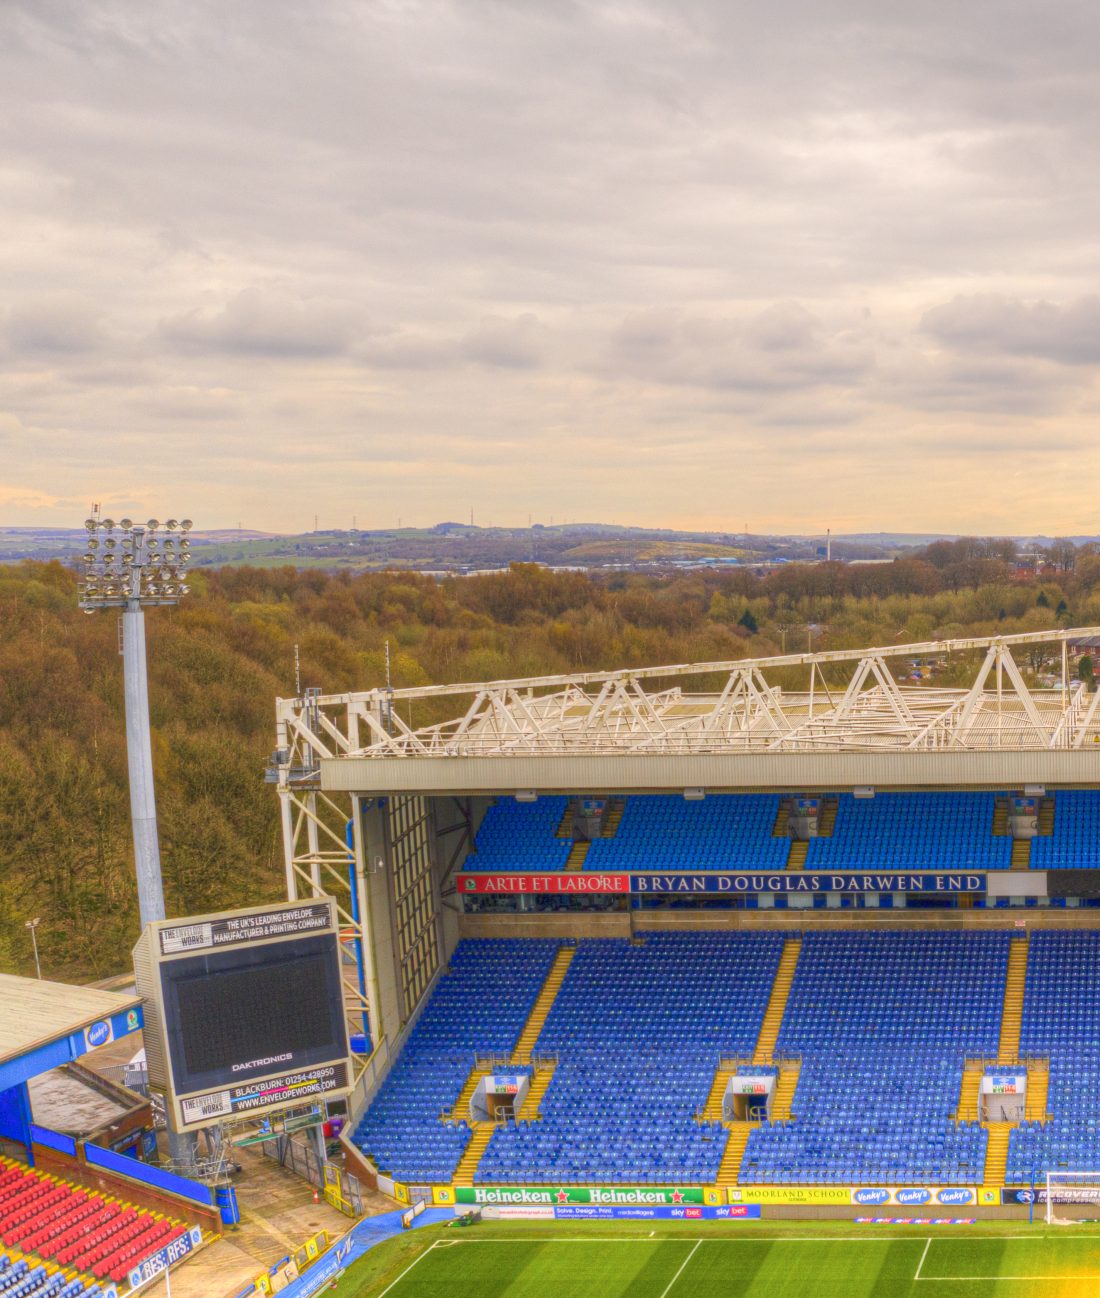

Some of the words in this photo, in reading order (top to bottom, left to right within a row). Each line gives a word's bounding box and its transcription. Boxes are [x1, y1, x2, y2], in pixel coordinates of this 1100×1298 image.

[484, 878, 526, 890] ARTE
[532, 878, 550, 890] ET
[557, 877, 622, 890] LABORE
[638, 878, 706, 890] BRYAN
[718, 876, 820, 890] DOUGLAS
[832, 876, 923, 890] DARWEN
[936, 876, 980, 890] END
[227, 920, 240, 931] THE
[240, 918, 255, 928] UK'S
[255, 912, 282, 926] LEADING
[282, 908, 312, 922] ENVELOPE
[214, 928, 264, 944] MANUFACTURER
[270, 922, 298, 935] PRINTING
[298, 917, 326, 932] COMPANY
[232, 1052, 293, 1072] DAKTRONICS
[236, 1080, 284, 1097] BLACKBURN:
[202, 1102, 224, 1115] WORKS
[475, 1189, 551, 1203] Heineken
[590, 1189, 666, 1203] Heineken
[808, 1190, 848, 1198] SCHOOL
[857, 1190, 886, 1202] Venky's
[899, 1190, 928, 1202] Venky's
[941, 1190, 970, 1202] Venky's
